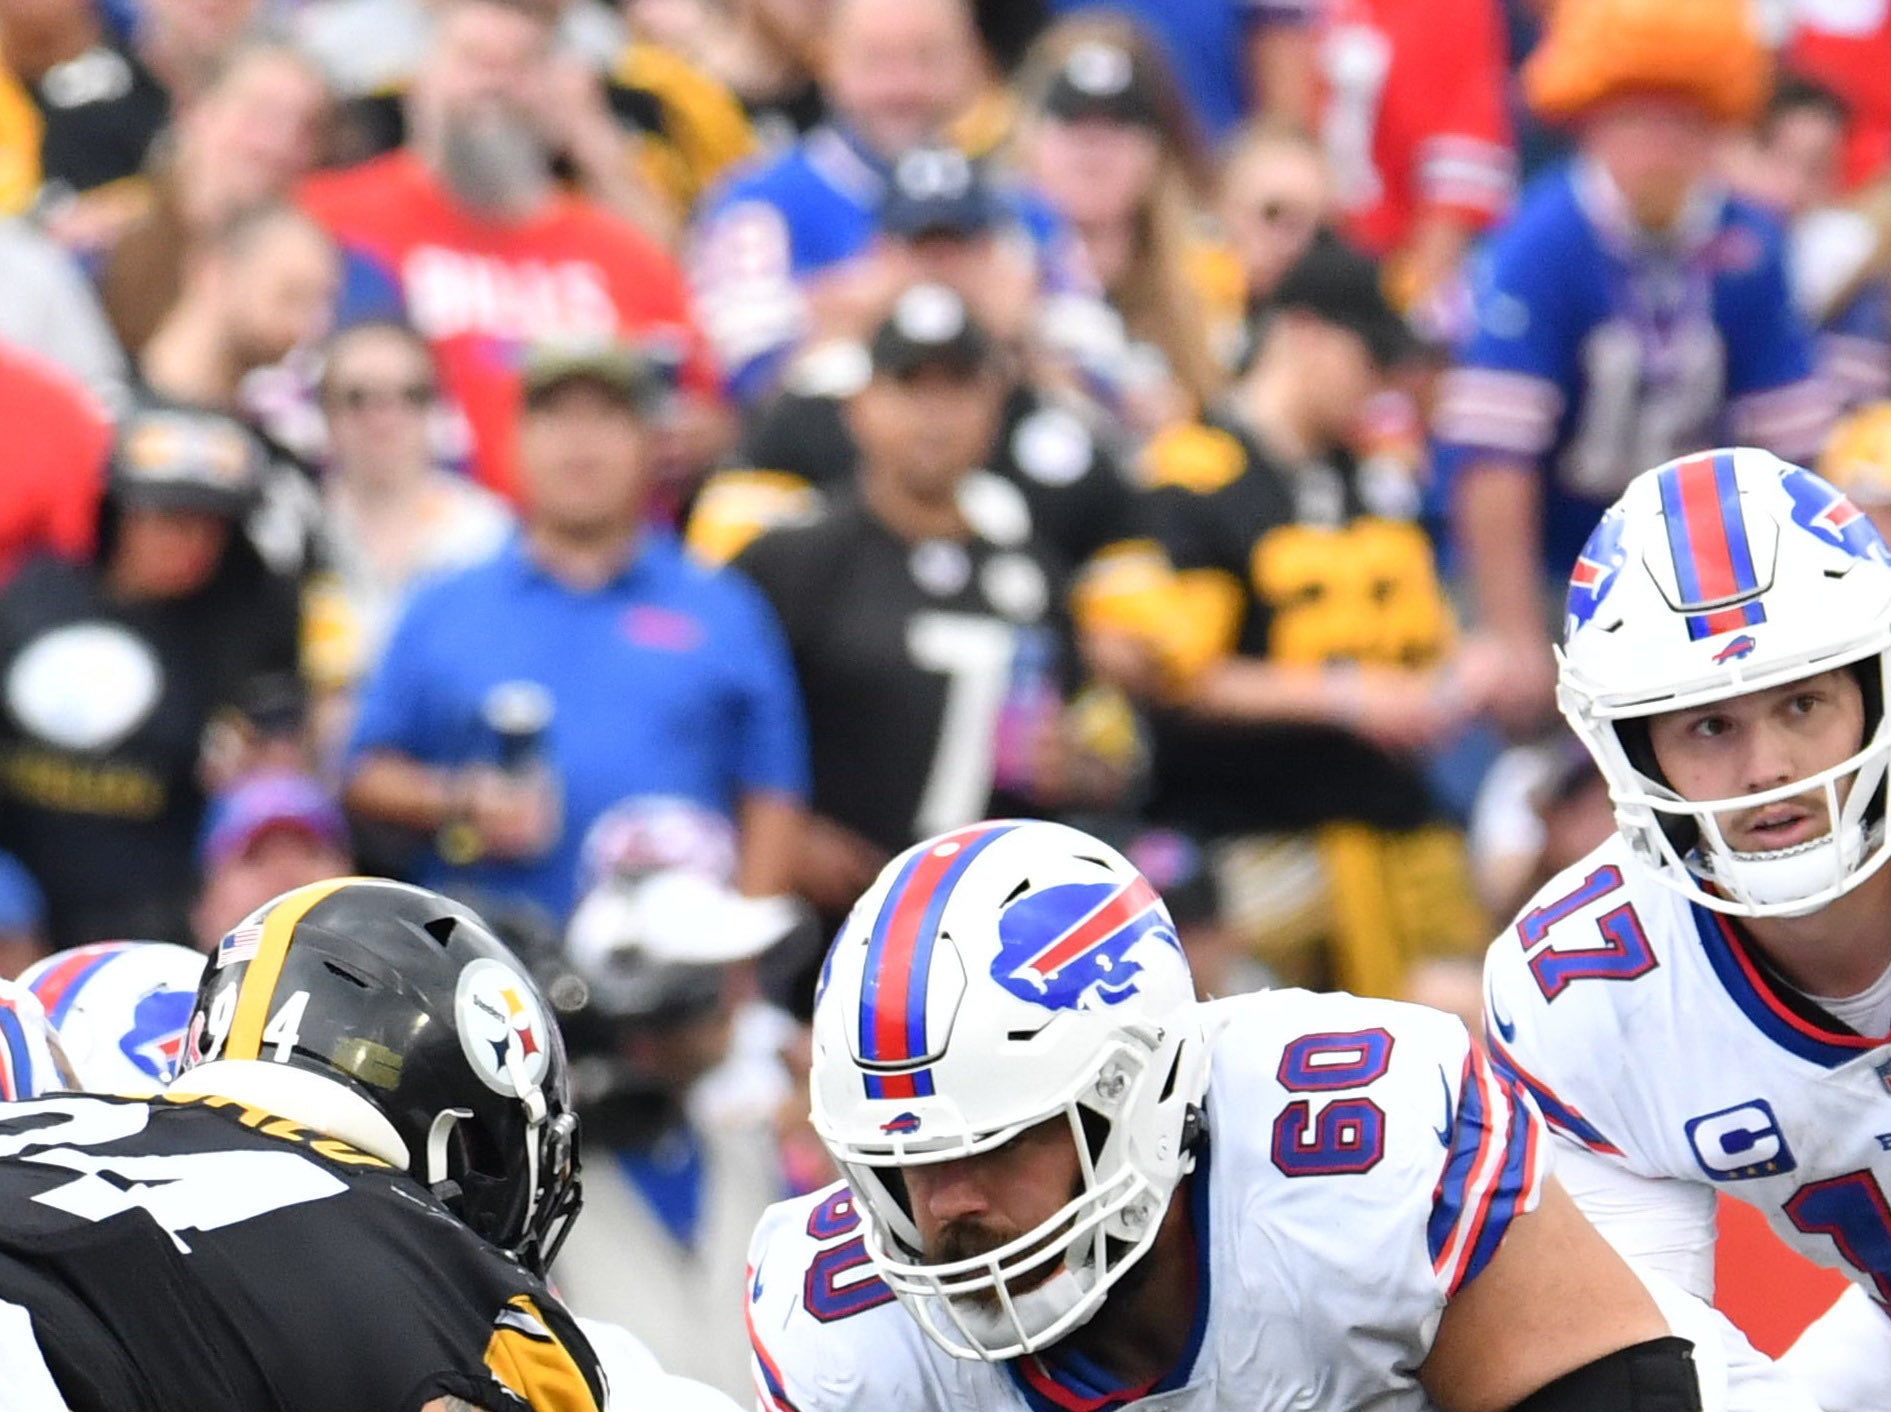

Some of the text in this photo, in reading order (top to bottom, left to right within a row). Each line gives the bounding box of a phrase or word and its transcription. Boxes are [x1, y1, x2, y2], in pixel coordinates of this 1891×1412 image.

[1516, 863, 1662, 1005] 17
[207, 980, 312, 1065] 94
[1272, 1027, 1396, 1178] 60
[1693, 1102, 1783, 1170] C
